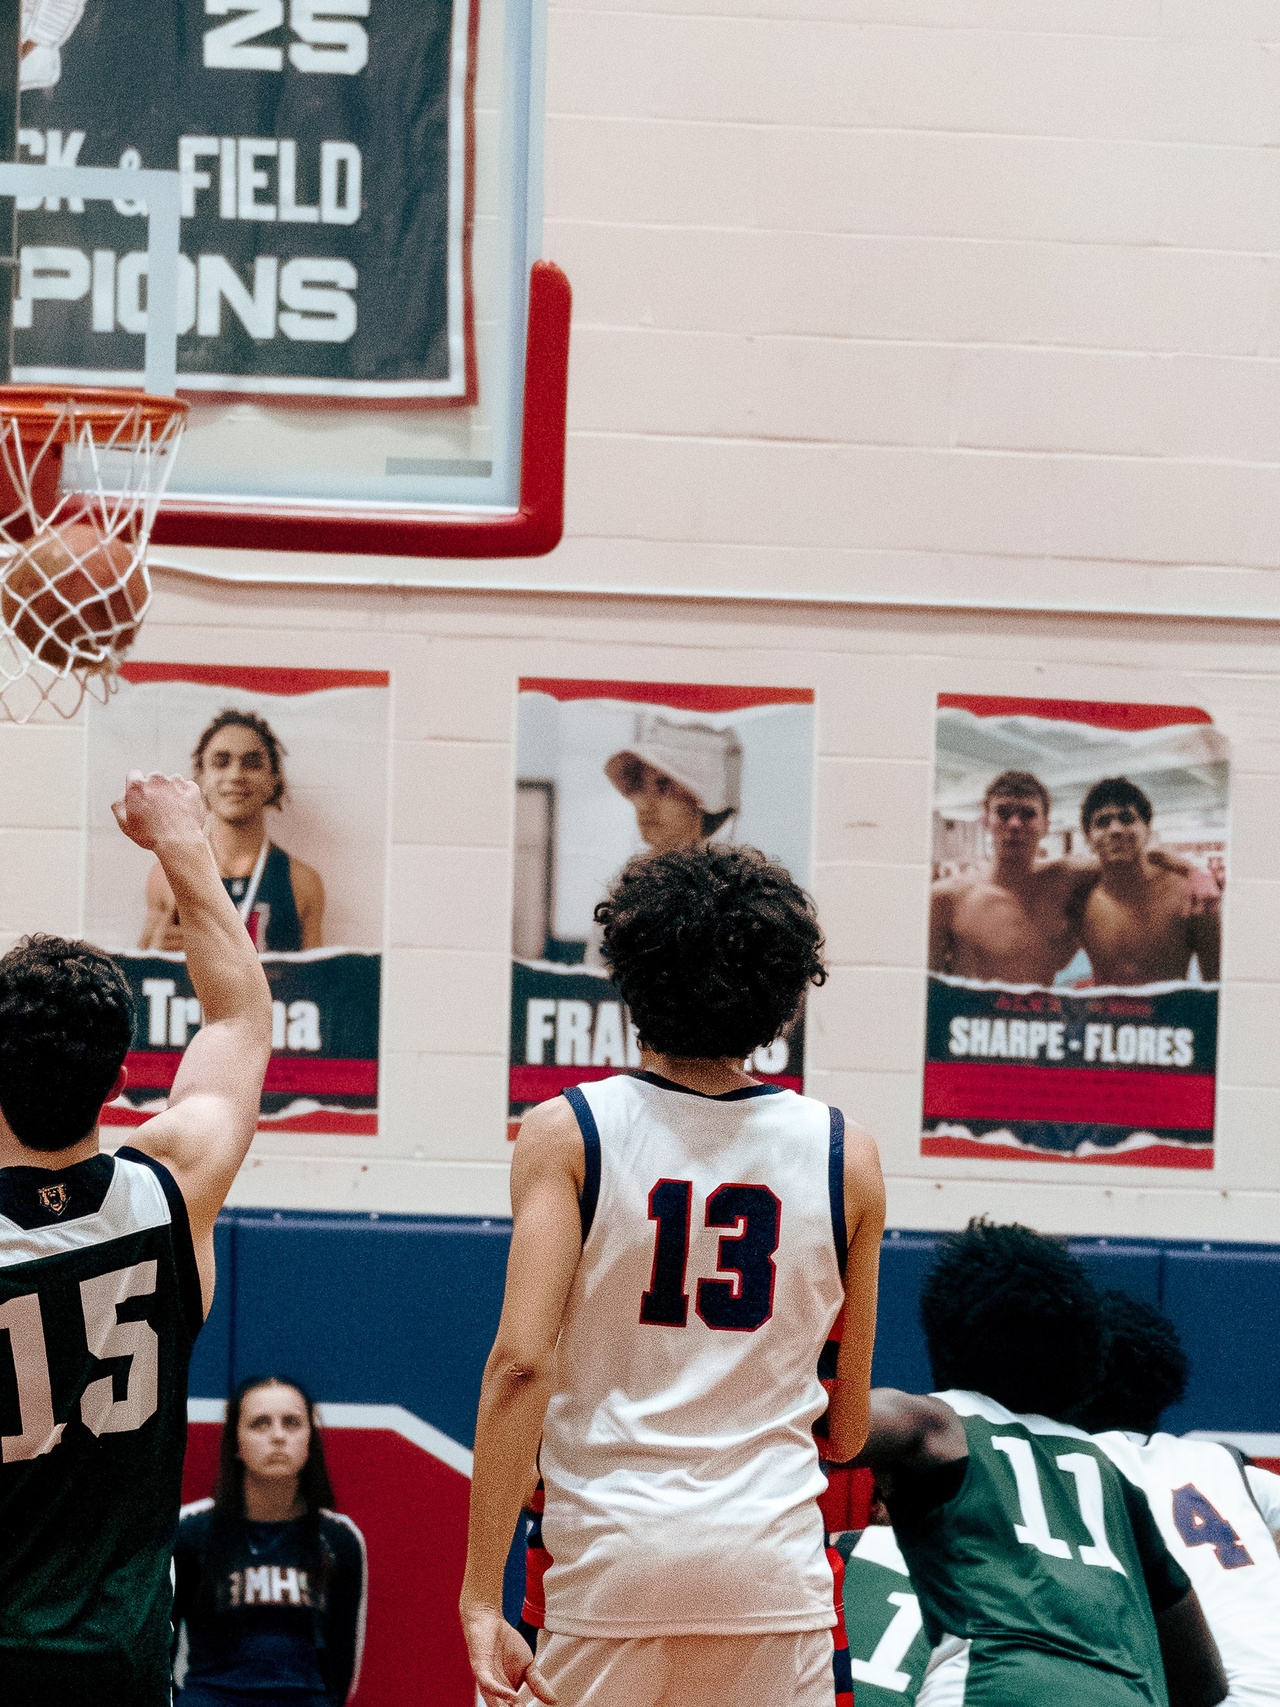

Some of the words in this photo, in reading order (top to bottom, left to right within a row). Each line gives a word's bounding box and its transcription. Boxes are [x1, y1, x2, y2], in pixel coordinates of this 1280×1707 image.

[203, 0, 370, 76] 25
[178, 135, 362, 226] FIELD
[639, 1178, 782, 1333] 13
[991, 1435, 1130, 1578] 11
[1171, 1482, 1255, 1570] 4
